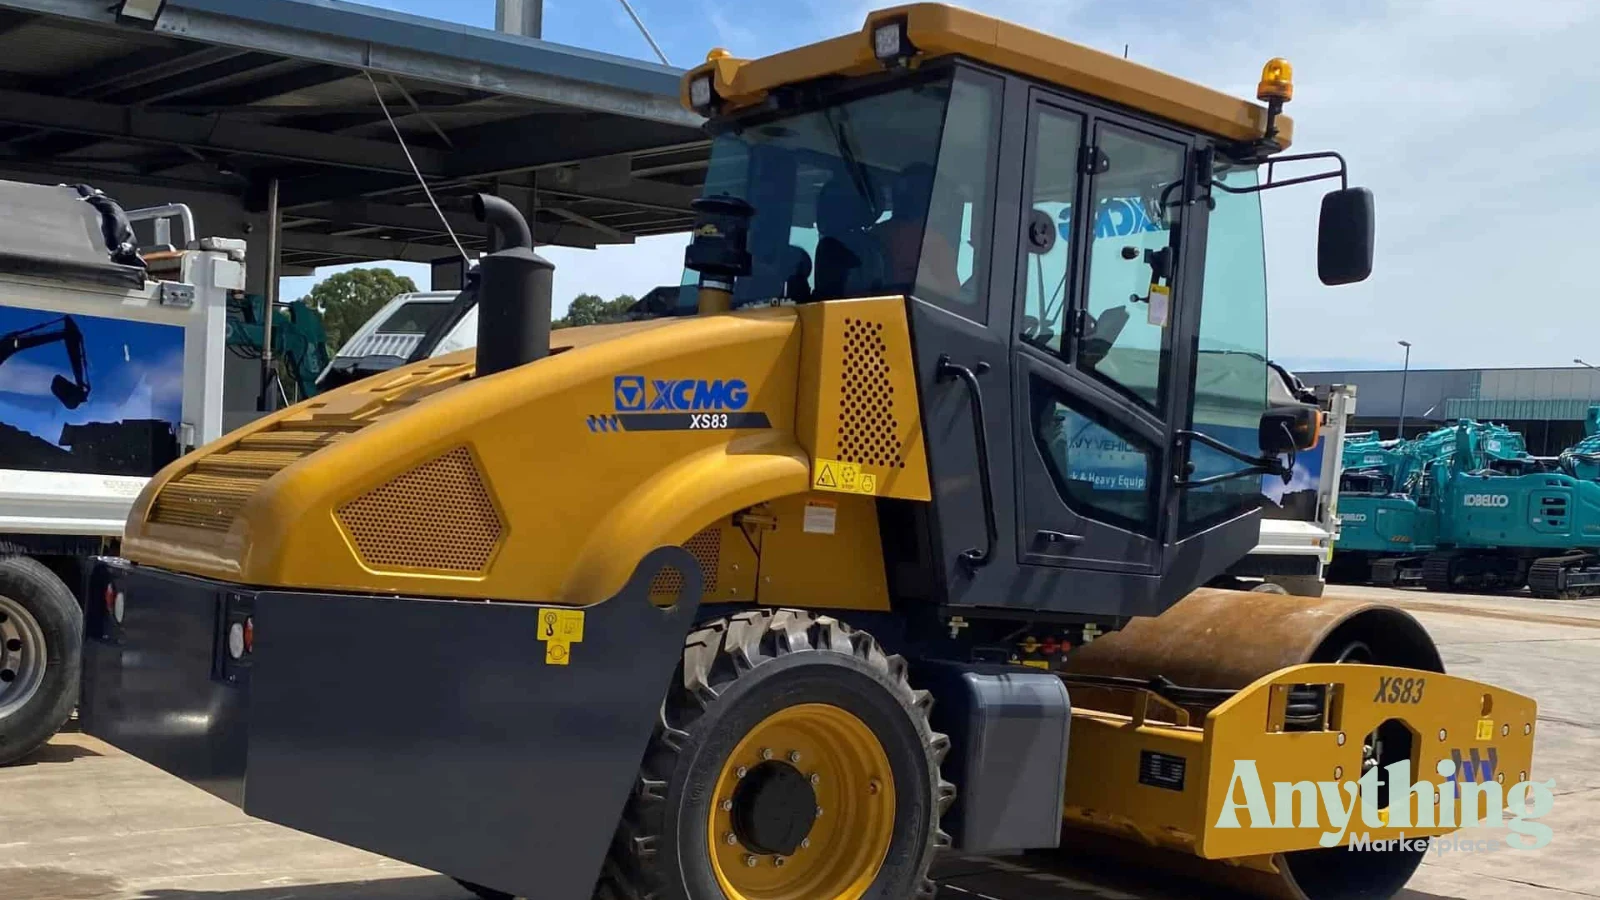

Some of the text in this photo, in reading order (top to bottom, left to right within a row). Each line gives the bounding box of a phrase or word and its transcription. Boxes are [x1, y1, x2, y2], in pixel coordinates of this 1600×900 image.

[648, 379, 748, 411] XCMG
[690, 413, 728, 429] XS83
[1088, 472, 1116, 488] Heavy
[1118, 474, 1145, 489] Equip
[1463, 493, 1509, 507] KOBELCO
[1373, 676, 1425, 704] XS83
